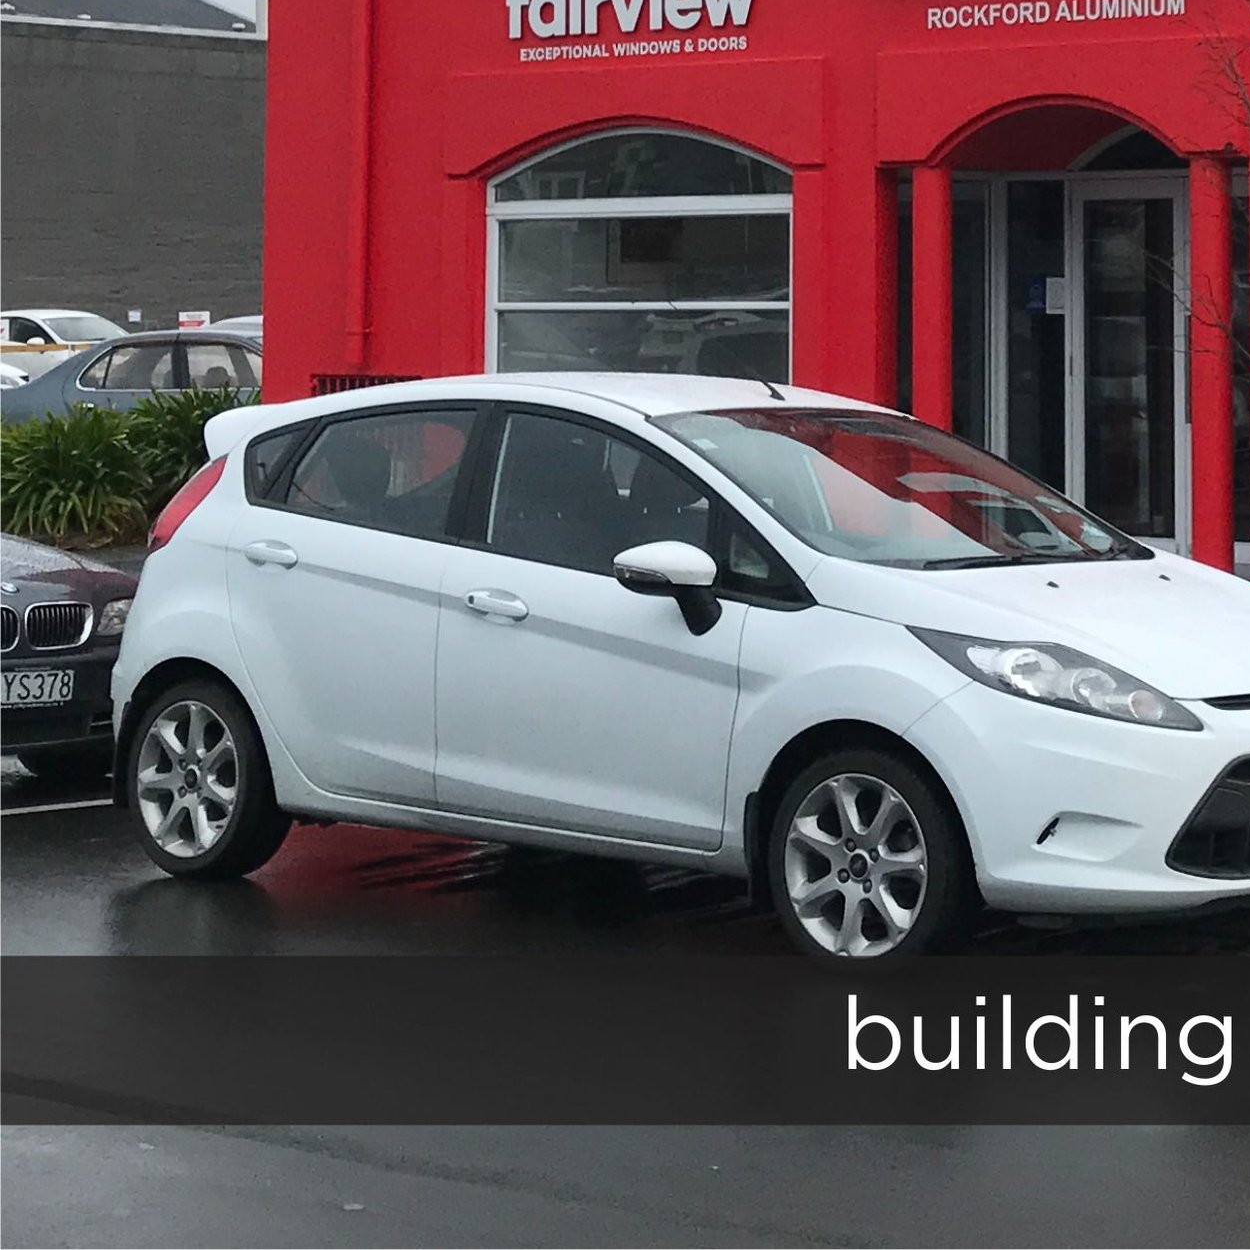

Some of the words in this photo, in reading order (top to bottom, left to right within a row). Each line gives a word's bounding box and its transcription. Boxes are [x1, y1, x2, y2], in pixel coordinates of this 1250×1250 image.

[927, 1, 1050, 29] ROCKFORD
[520, 43, 609, 62] EXCEPTIONAL
[612, 39, 680, 57] WINDOWS
[684, 38, 694, 52] &
[698, 36, 747, 52] DOORS
